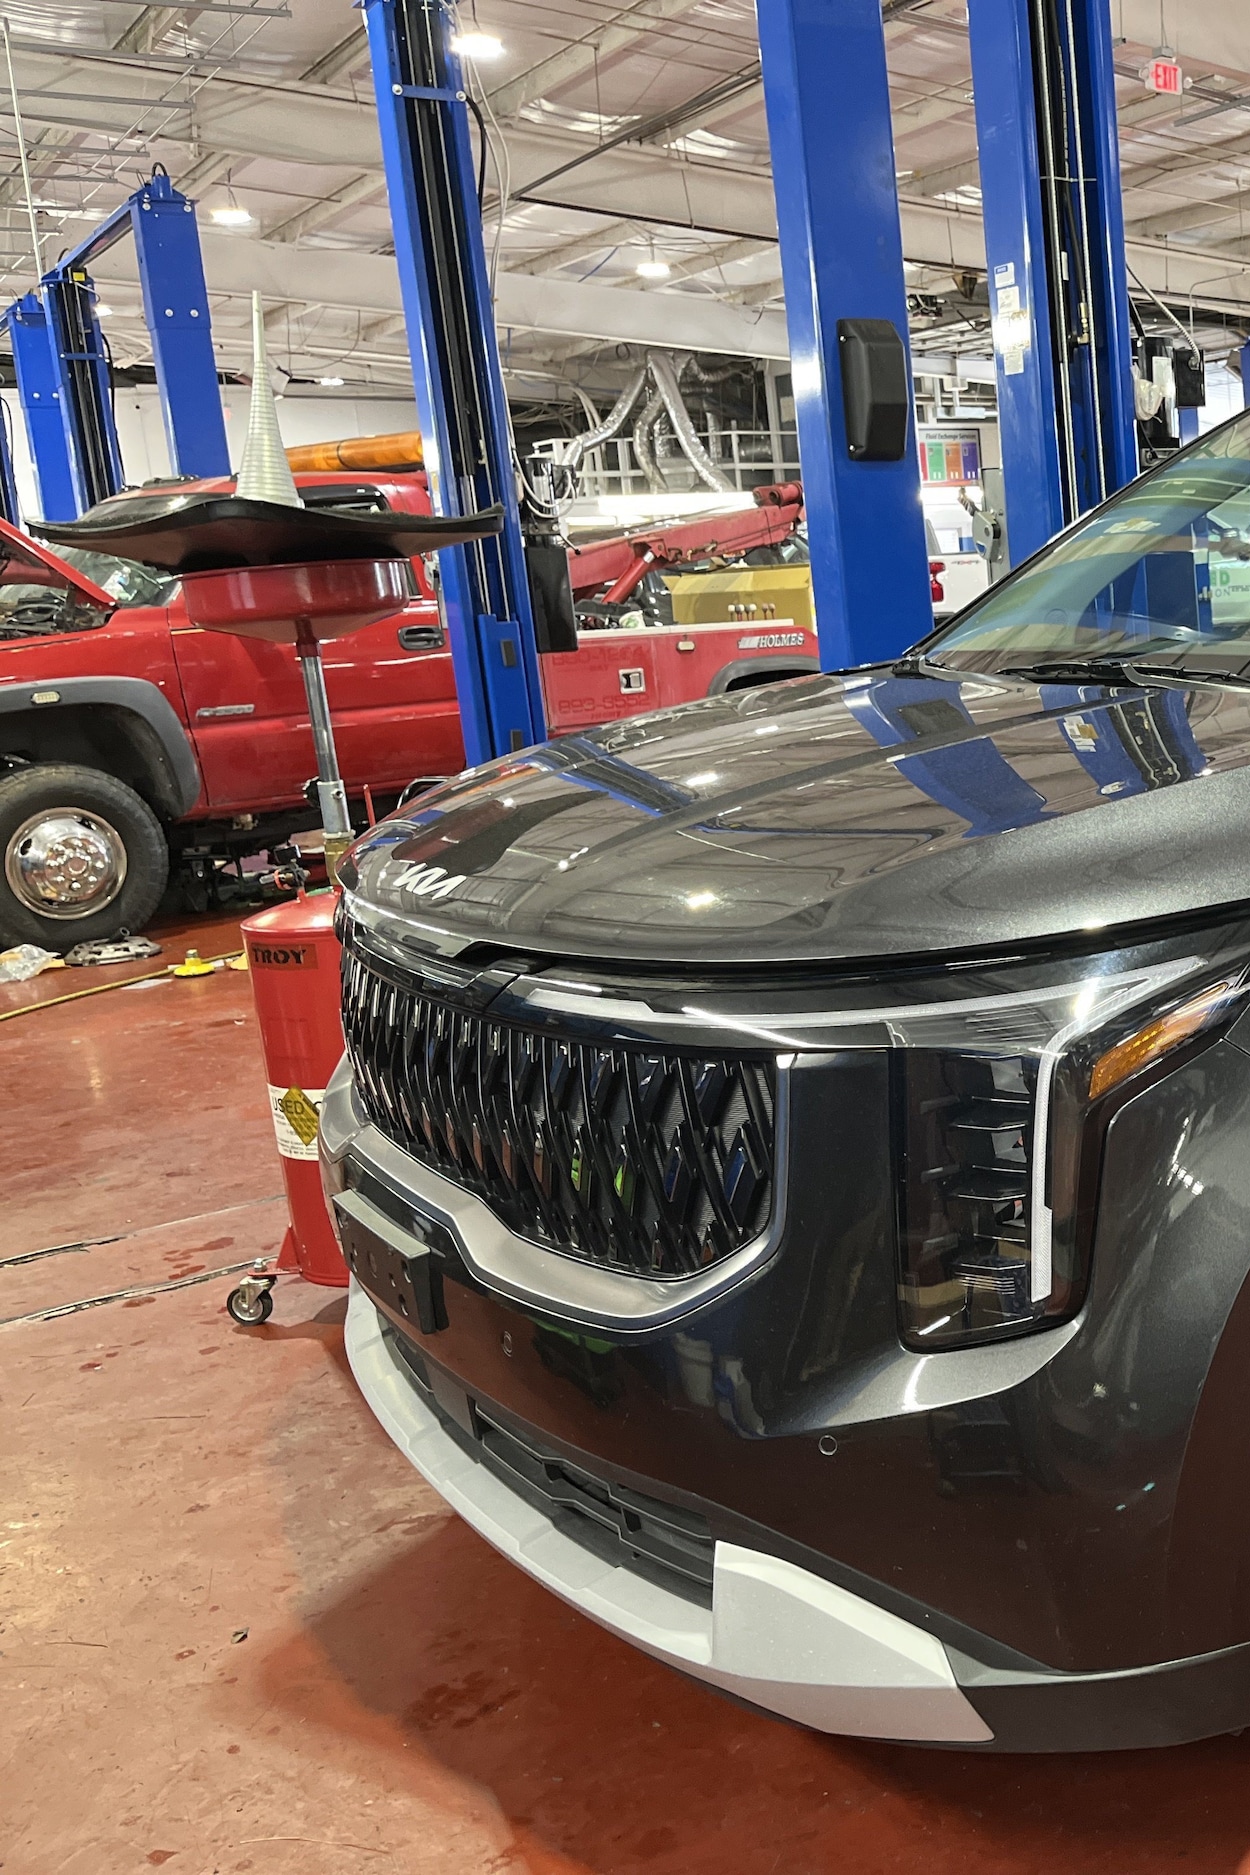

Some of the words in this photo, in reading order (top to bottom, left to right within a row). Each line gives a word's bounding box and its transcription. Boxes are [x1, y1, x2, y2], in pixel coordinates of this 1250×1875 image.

[1155, 63, 1178, 92] EXIT
[759, 632, 805, 648] HOLMES
[252, 948, 306, 965] TROY
[271, 1096, 305, 1115] USED
